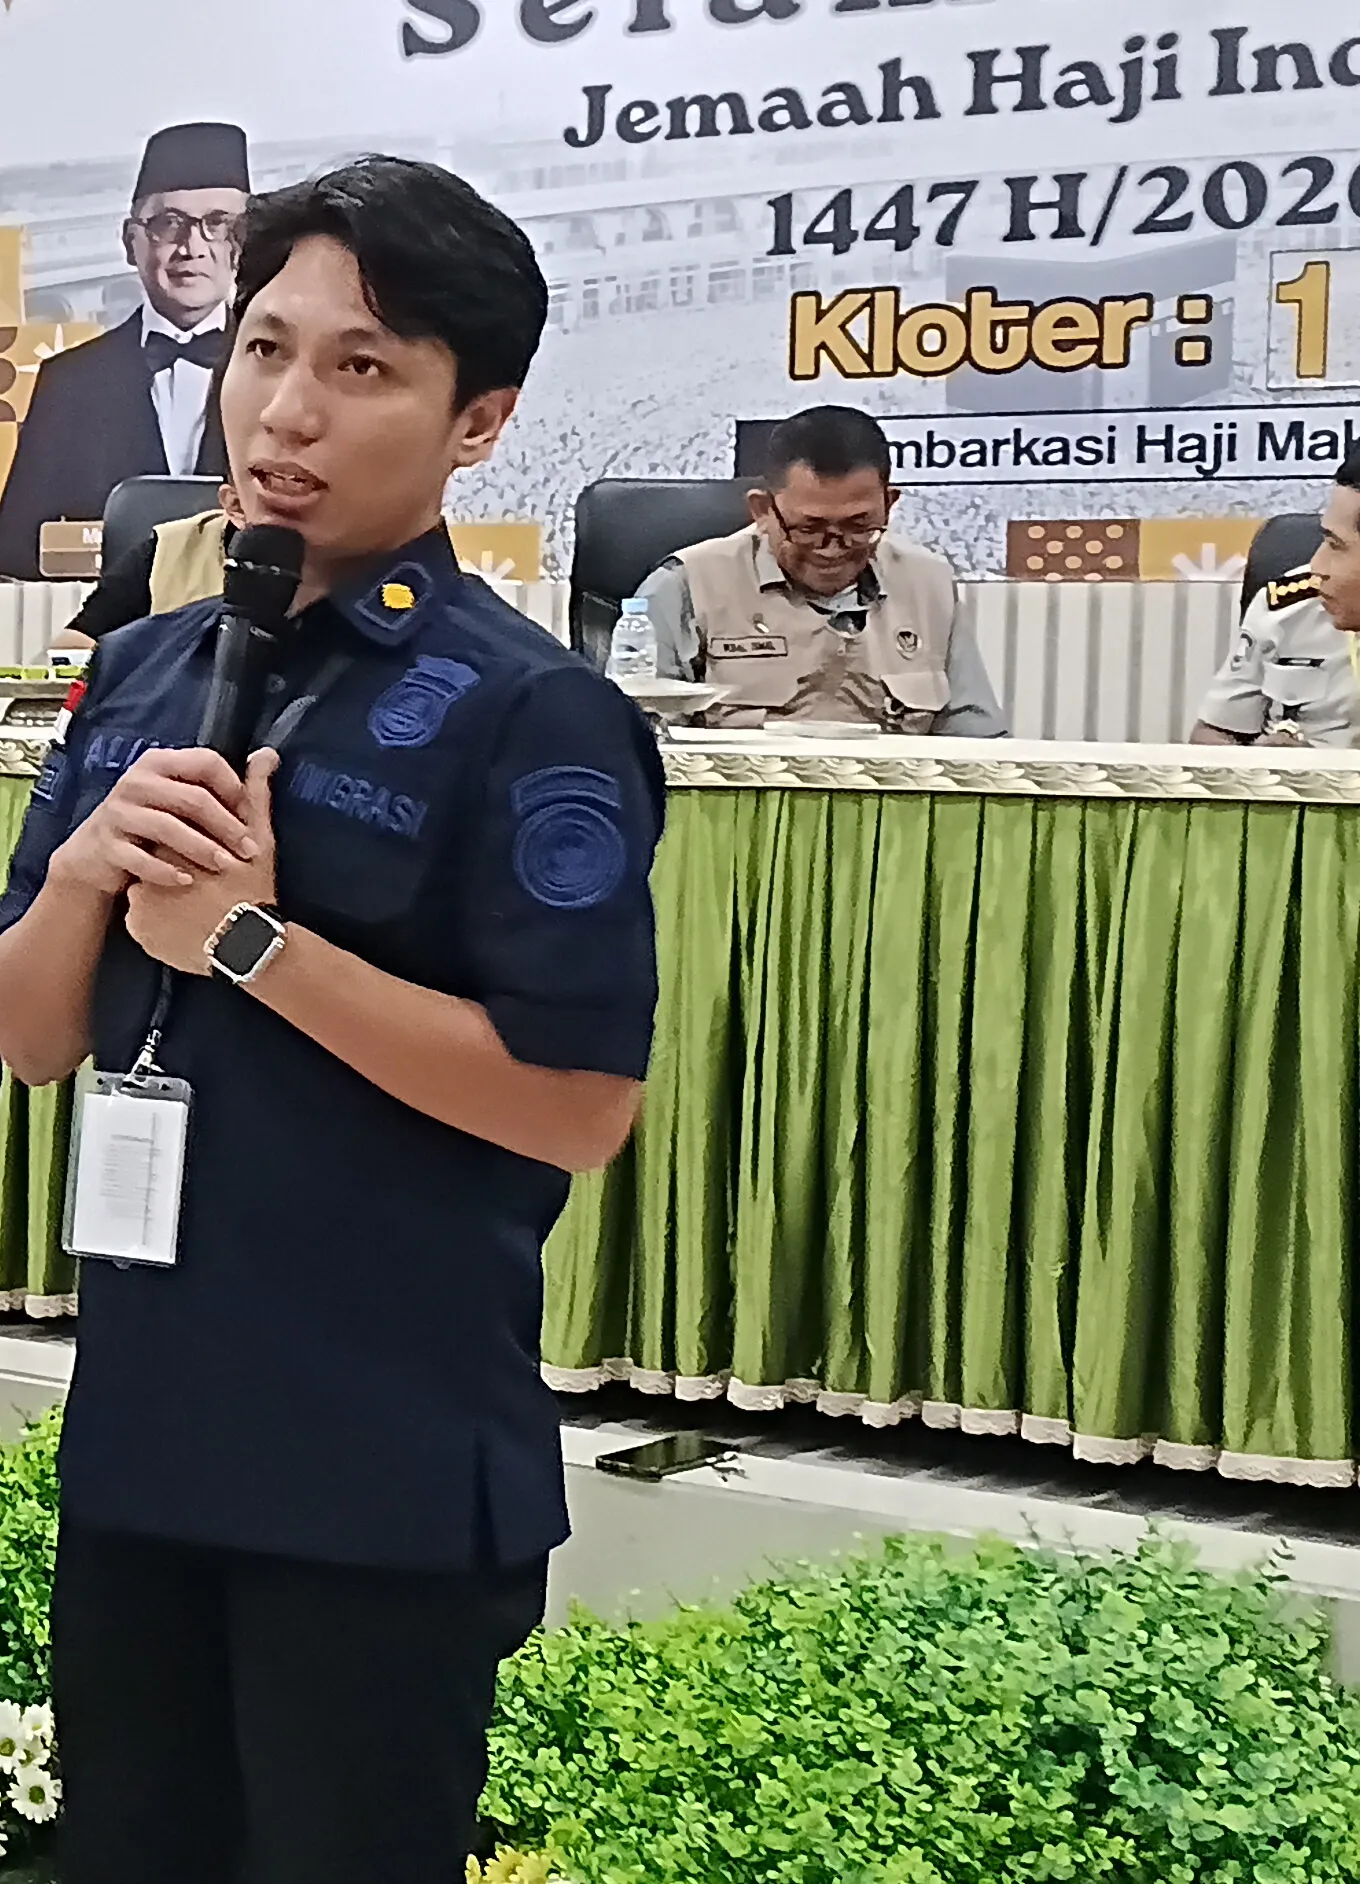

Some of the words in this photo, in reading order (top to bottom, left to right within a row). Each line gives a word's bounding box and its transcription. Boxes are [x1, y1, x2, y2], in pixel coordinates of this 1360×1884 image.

[563, 57, 942, 148] Jemaah
[963, 32, 1182, 124] Haji
[765, 179, 980, 256] 1447
[1001, 155, 1360, 253] H/202
[789, 286, 1153, 380] Kloter
[1276, 260, 1331, 379] 1
[886, 425, 1116, 469] mbarkasi
[1136, 422, 1237, 477] Haji
